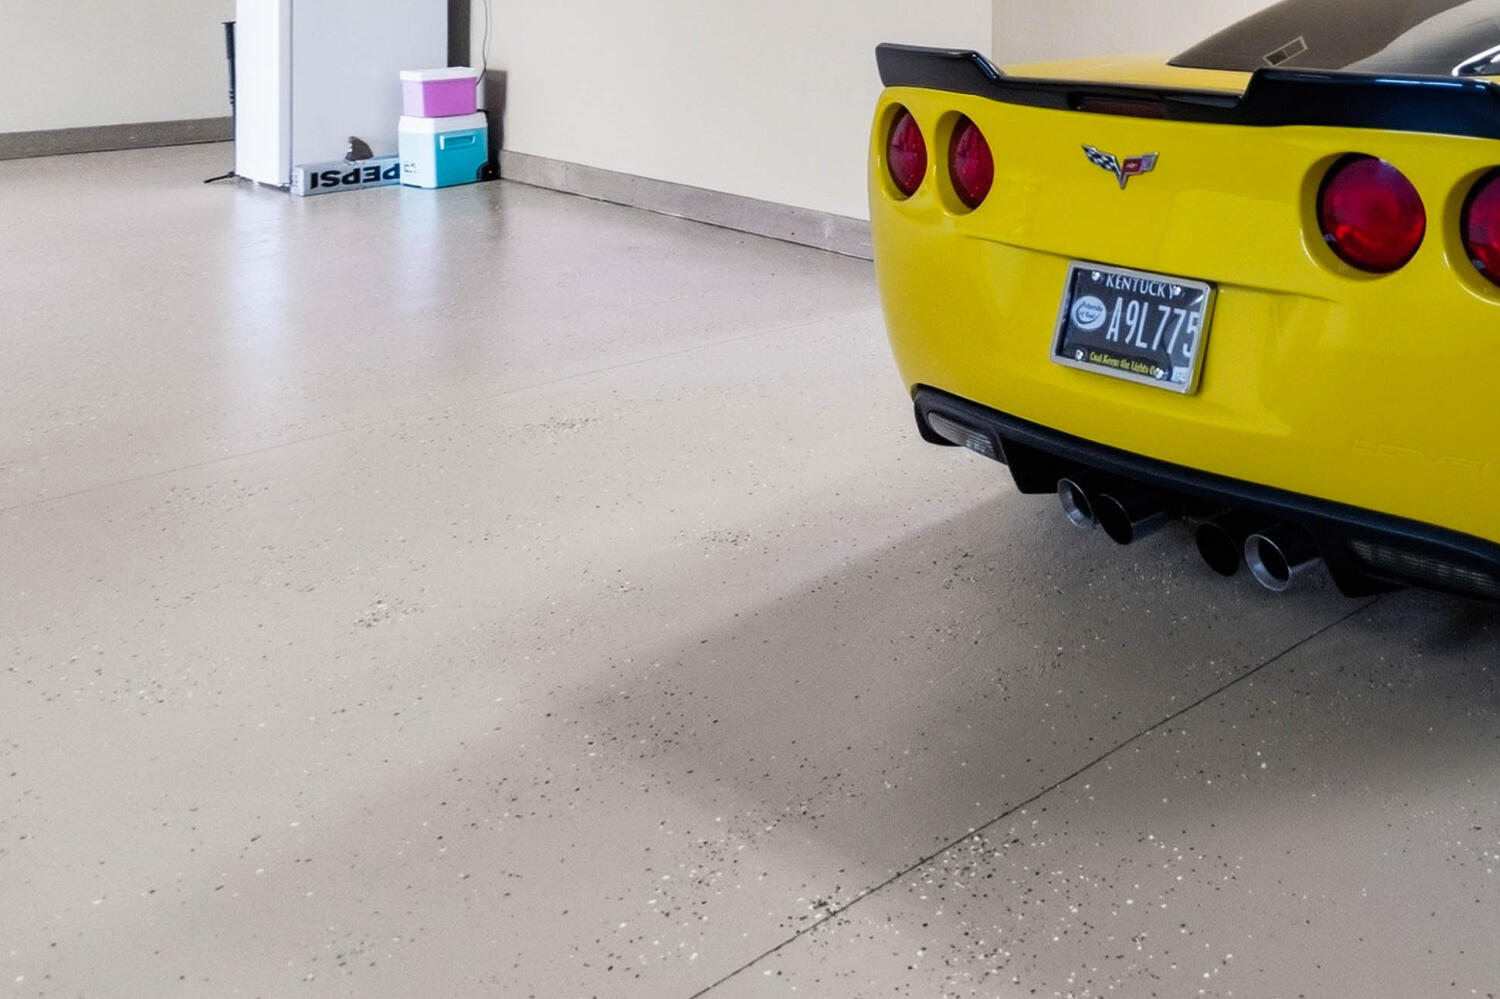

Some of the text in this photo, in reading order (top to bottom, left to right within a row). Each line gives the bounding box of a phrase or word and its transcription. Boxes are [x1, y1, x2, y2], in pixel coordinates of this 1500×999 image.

[310, 163, 401, 190] PEPSI
[1105, 274, 1177, 300] KENTUCKY
[1105, 296, 1200, 359] A9L775
